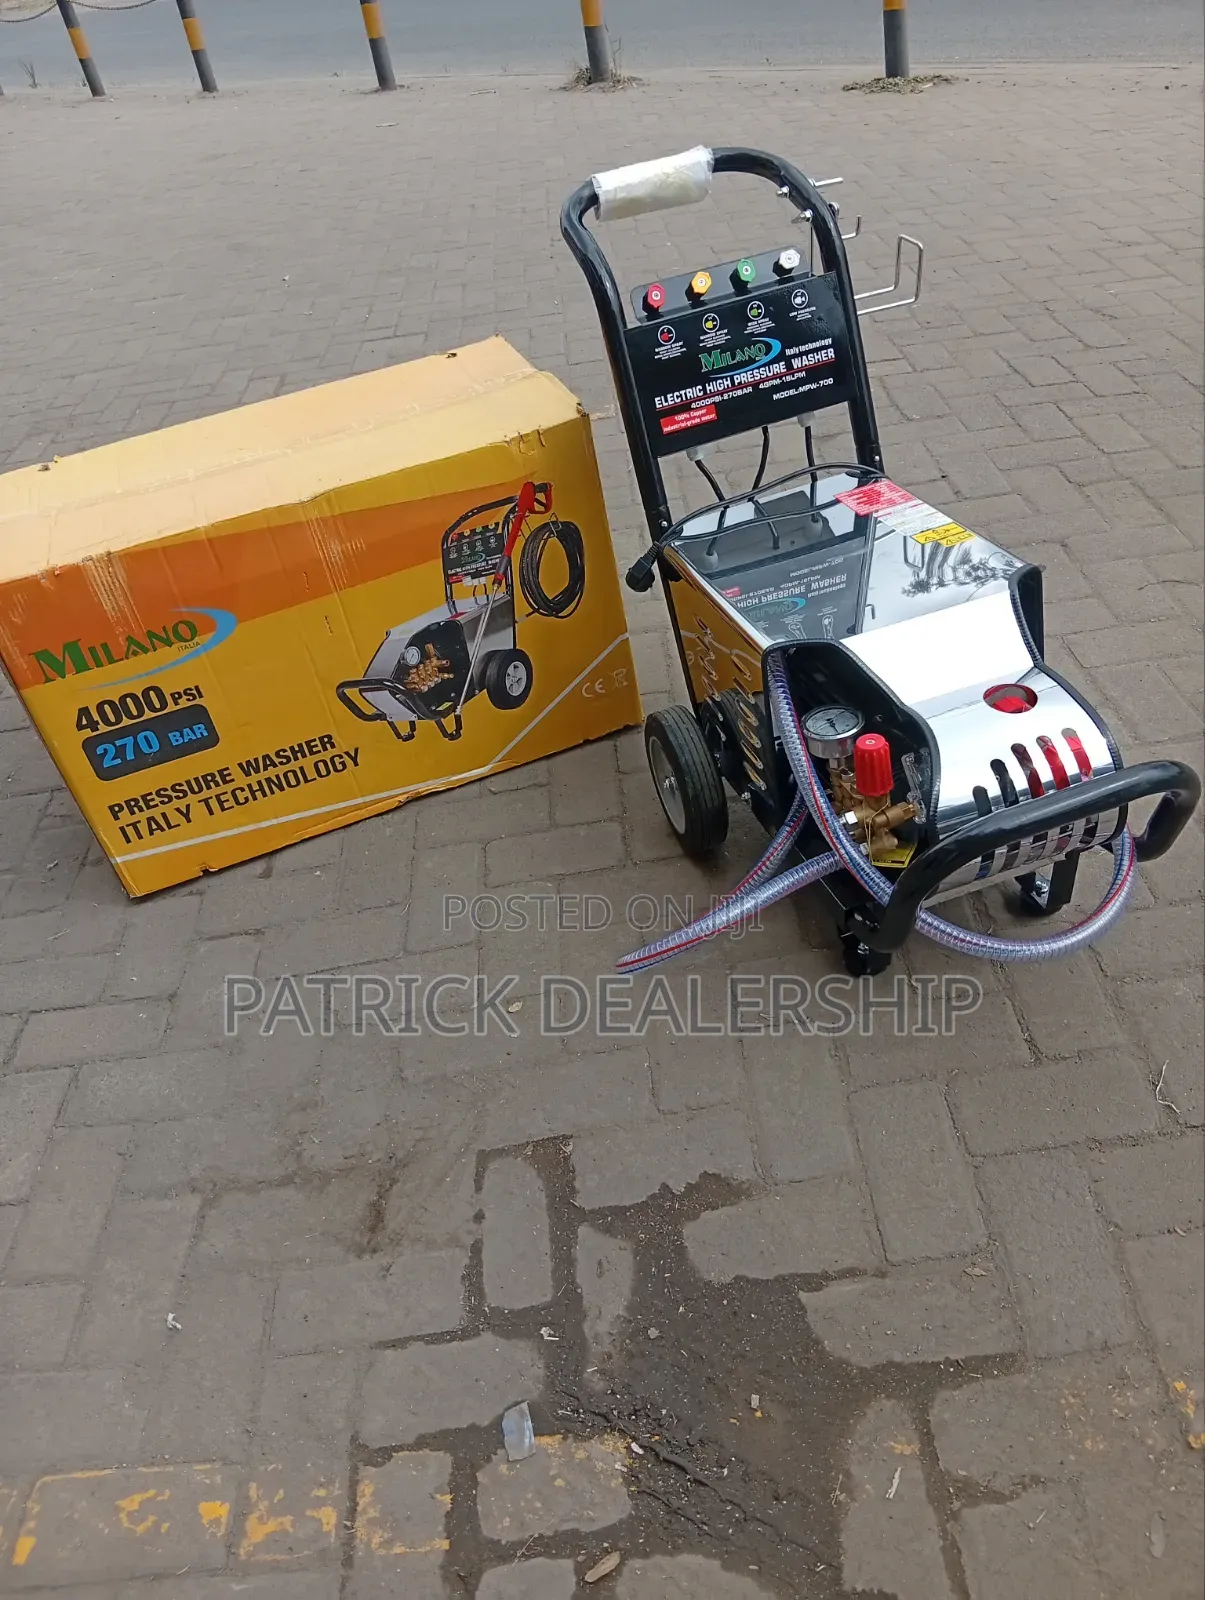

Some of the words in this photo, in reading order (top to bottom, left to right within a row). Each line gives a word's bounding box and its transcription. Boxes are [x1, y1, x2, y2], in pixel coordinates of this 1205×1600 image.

[698, 343, 766, 372] MILANO
[799, 337, 832, 354] technology
[654, 384, 704, 409] ELECTRIC
[705, 375, 732, 394] HIGH
[733, 361, 787, 387] PRESSURE
[791, 347, 836, 370] WASHER
[32, 618, 199, 686] MILANO
[176, 640, 201, 653] ITALIA
[75, 684, 169, 734] 4000
[170, 685, 206, 708] PSI
[95, 730, 161, 770] 270
[168, 723, 210, 748] BAR
[107, 765, 236, 822] PRESSURE
[236, 733, 337, 778] WASHER
[117, 802, 192, 845] ITALY
[197, 747, 362, 818] TECHNOLOGY
